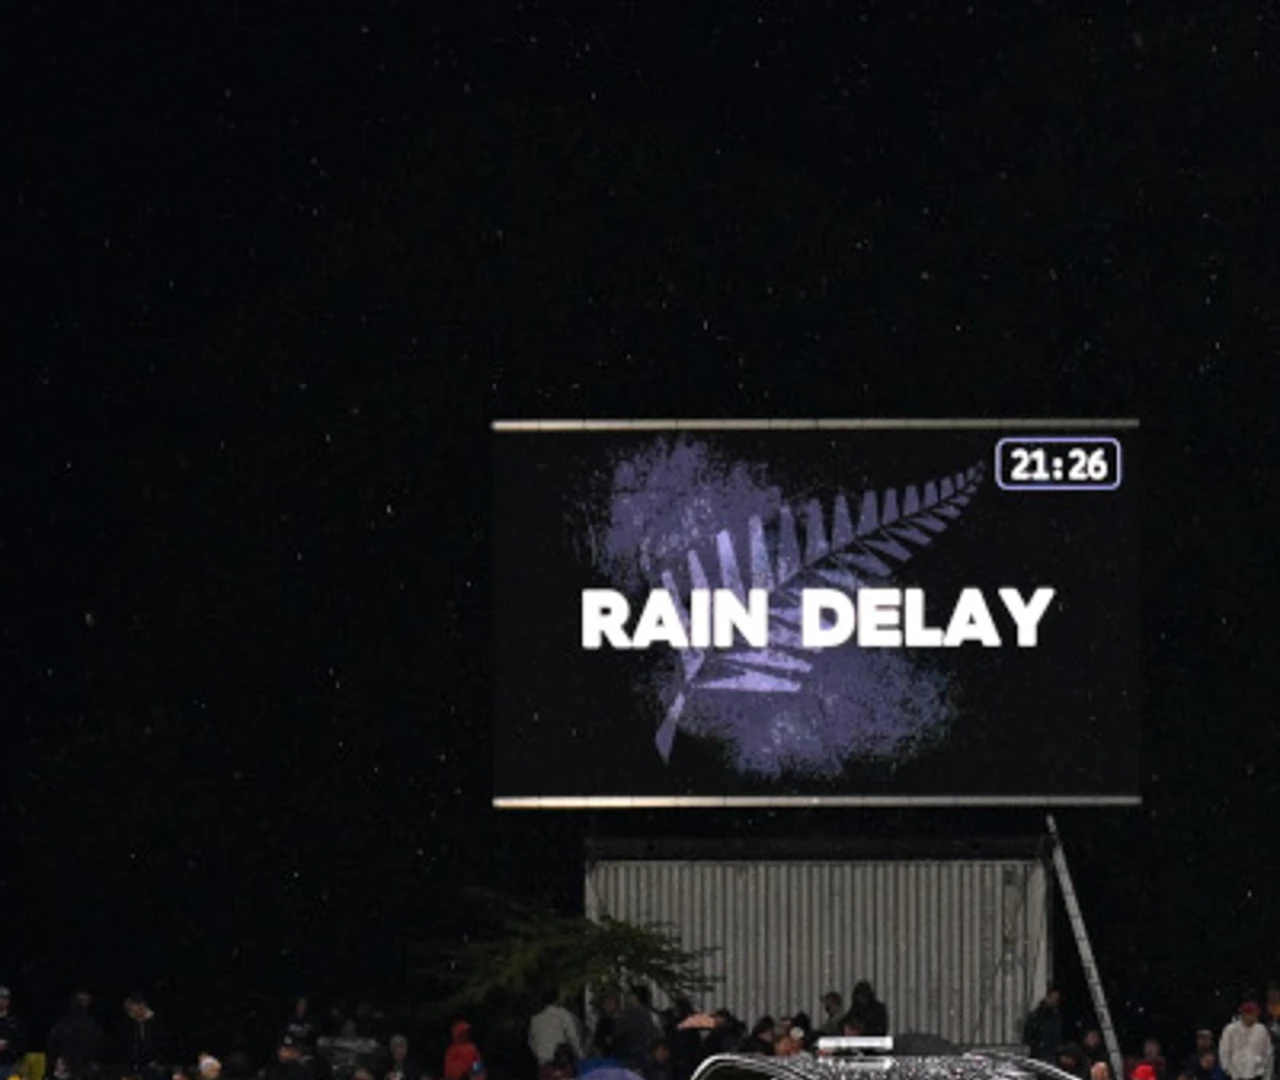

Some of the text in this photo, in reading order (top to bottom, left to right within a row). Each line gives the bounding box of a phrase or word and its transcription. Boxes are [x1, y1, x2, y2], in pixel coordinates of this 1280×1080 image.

[1010, 448, 1109, 481] 21:26
[581, 587, 1056, 649] RAIN DELAY
